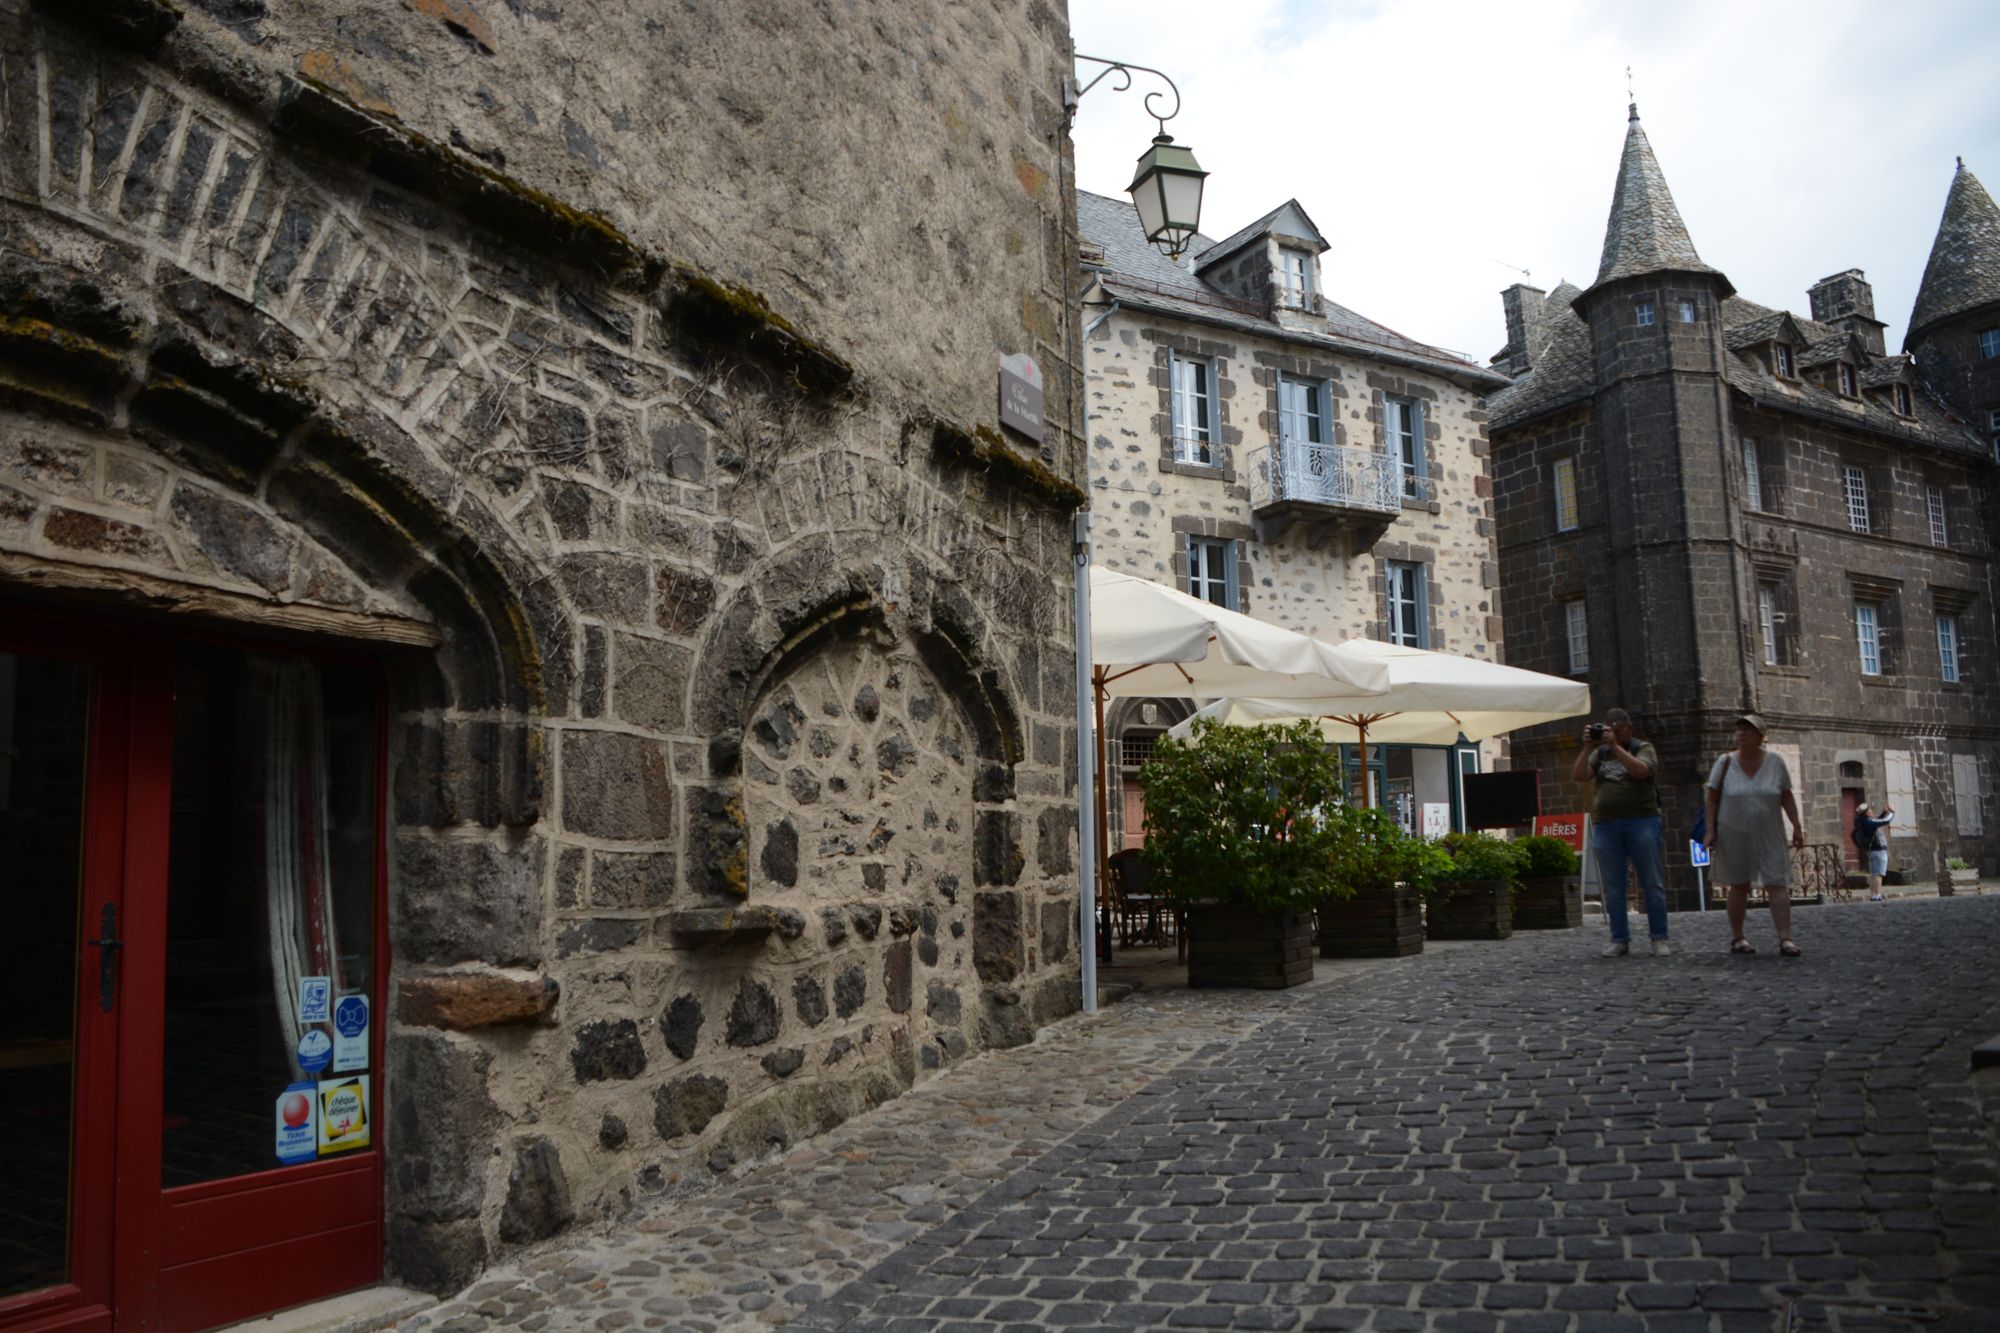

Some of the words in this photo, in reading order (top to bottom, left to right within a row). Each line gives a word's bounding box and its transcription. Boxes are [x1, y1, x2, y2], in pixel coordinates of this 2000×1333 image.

[1543, 822, 1577, 836] BIÈRES
[331, 1095, 357, 1109] chèque
[328, 1104, 359, 1118] déjeuner
